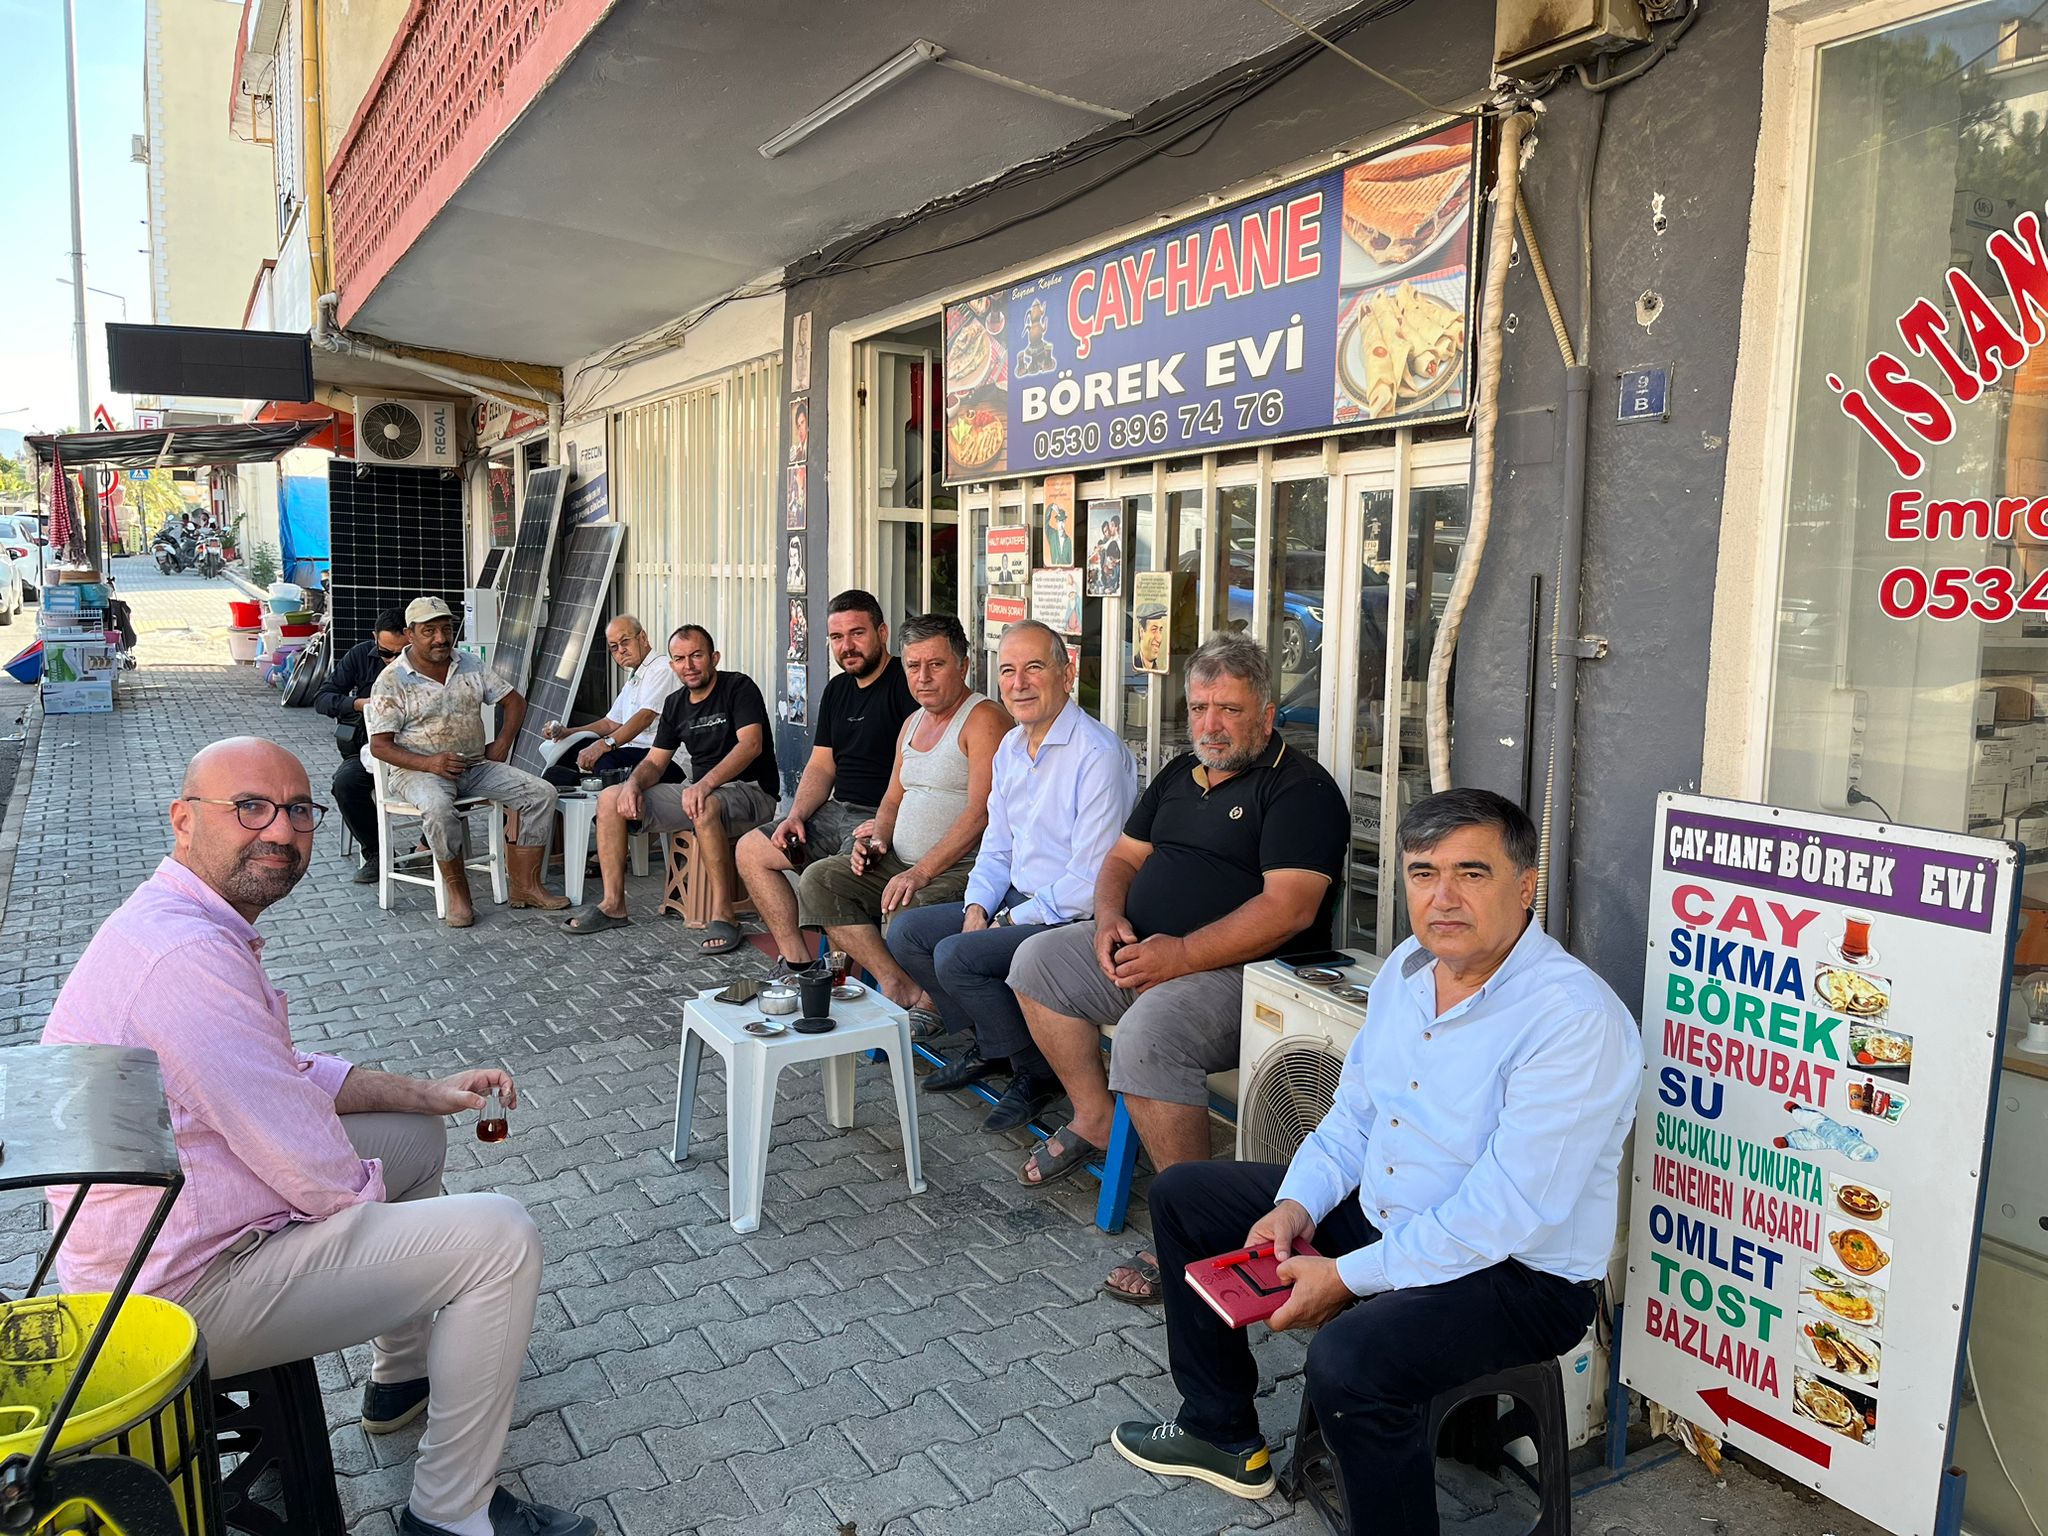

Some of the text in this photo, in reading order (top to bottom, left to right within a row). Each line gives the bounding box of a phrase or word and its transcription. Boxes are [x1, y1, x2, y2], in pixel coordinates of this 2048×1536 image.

[1067, 192, 1323, 358] ÇAY-HANE
[1021, 313, 1304, 424] BÖREK EVİ
[1637, 375, 1650, 388] 9
[1825, 199, 2048, 480] İSTAN
[434, 408, 446, 455] REGAL
[1033, 389, 1284, 460] 0530 896 74 76
[1634, 397, 1649, 411] B
[988, 602, 1024, 617] TÜRKAN ŞORAY
[1878, 565, 2048, 623] 0534
[1670, 825, 1987, 914] ÇAY-HANE BÖREK EVİ
[1671, 884, 1821, 949] ÇAY
[1668, 927, 1806, 1002] SIKMA
[1666, 972, 1844, 1062] BÖREK
[1658, 1067, 1725, 1120] SU
[1663, 1019, 1836, 1108] MEŞRUBAT
[1656, 1111, 1823, 1207] SUCUKLU YUMURTA
[1649, 1204, 1784, 1291] OMLET
[1652, 1154, 1821, 1254] MENEMEN KAŞARLI
[1650, 1251, 1783, 1343] TOST
[1646, 1297, 1780, 1399] BAZLAMA
